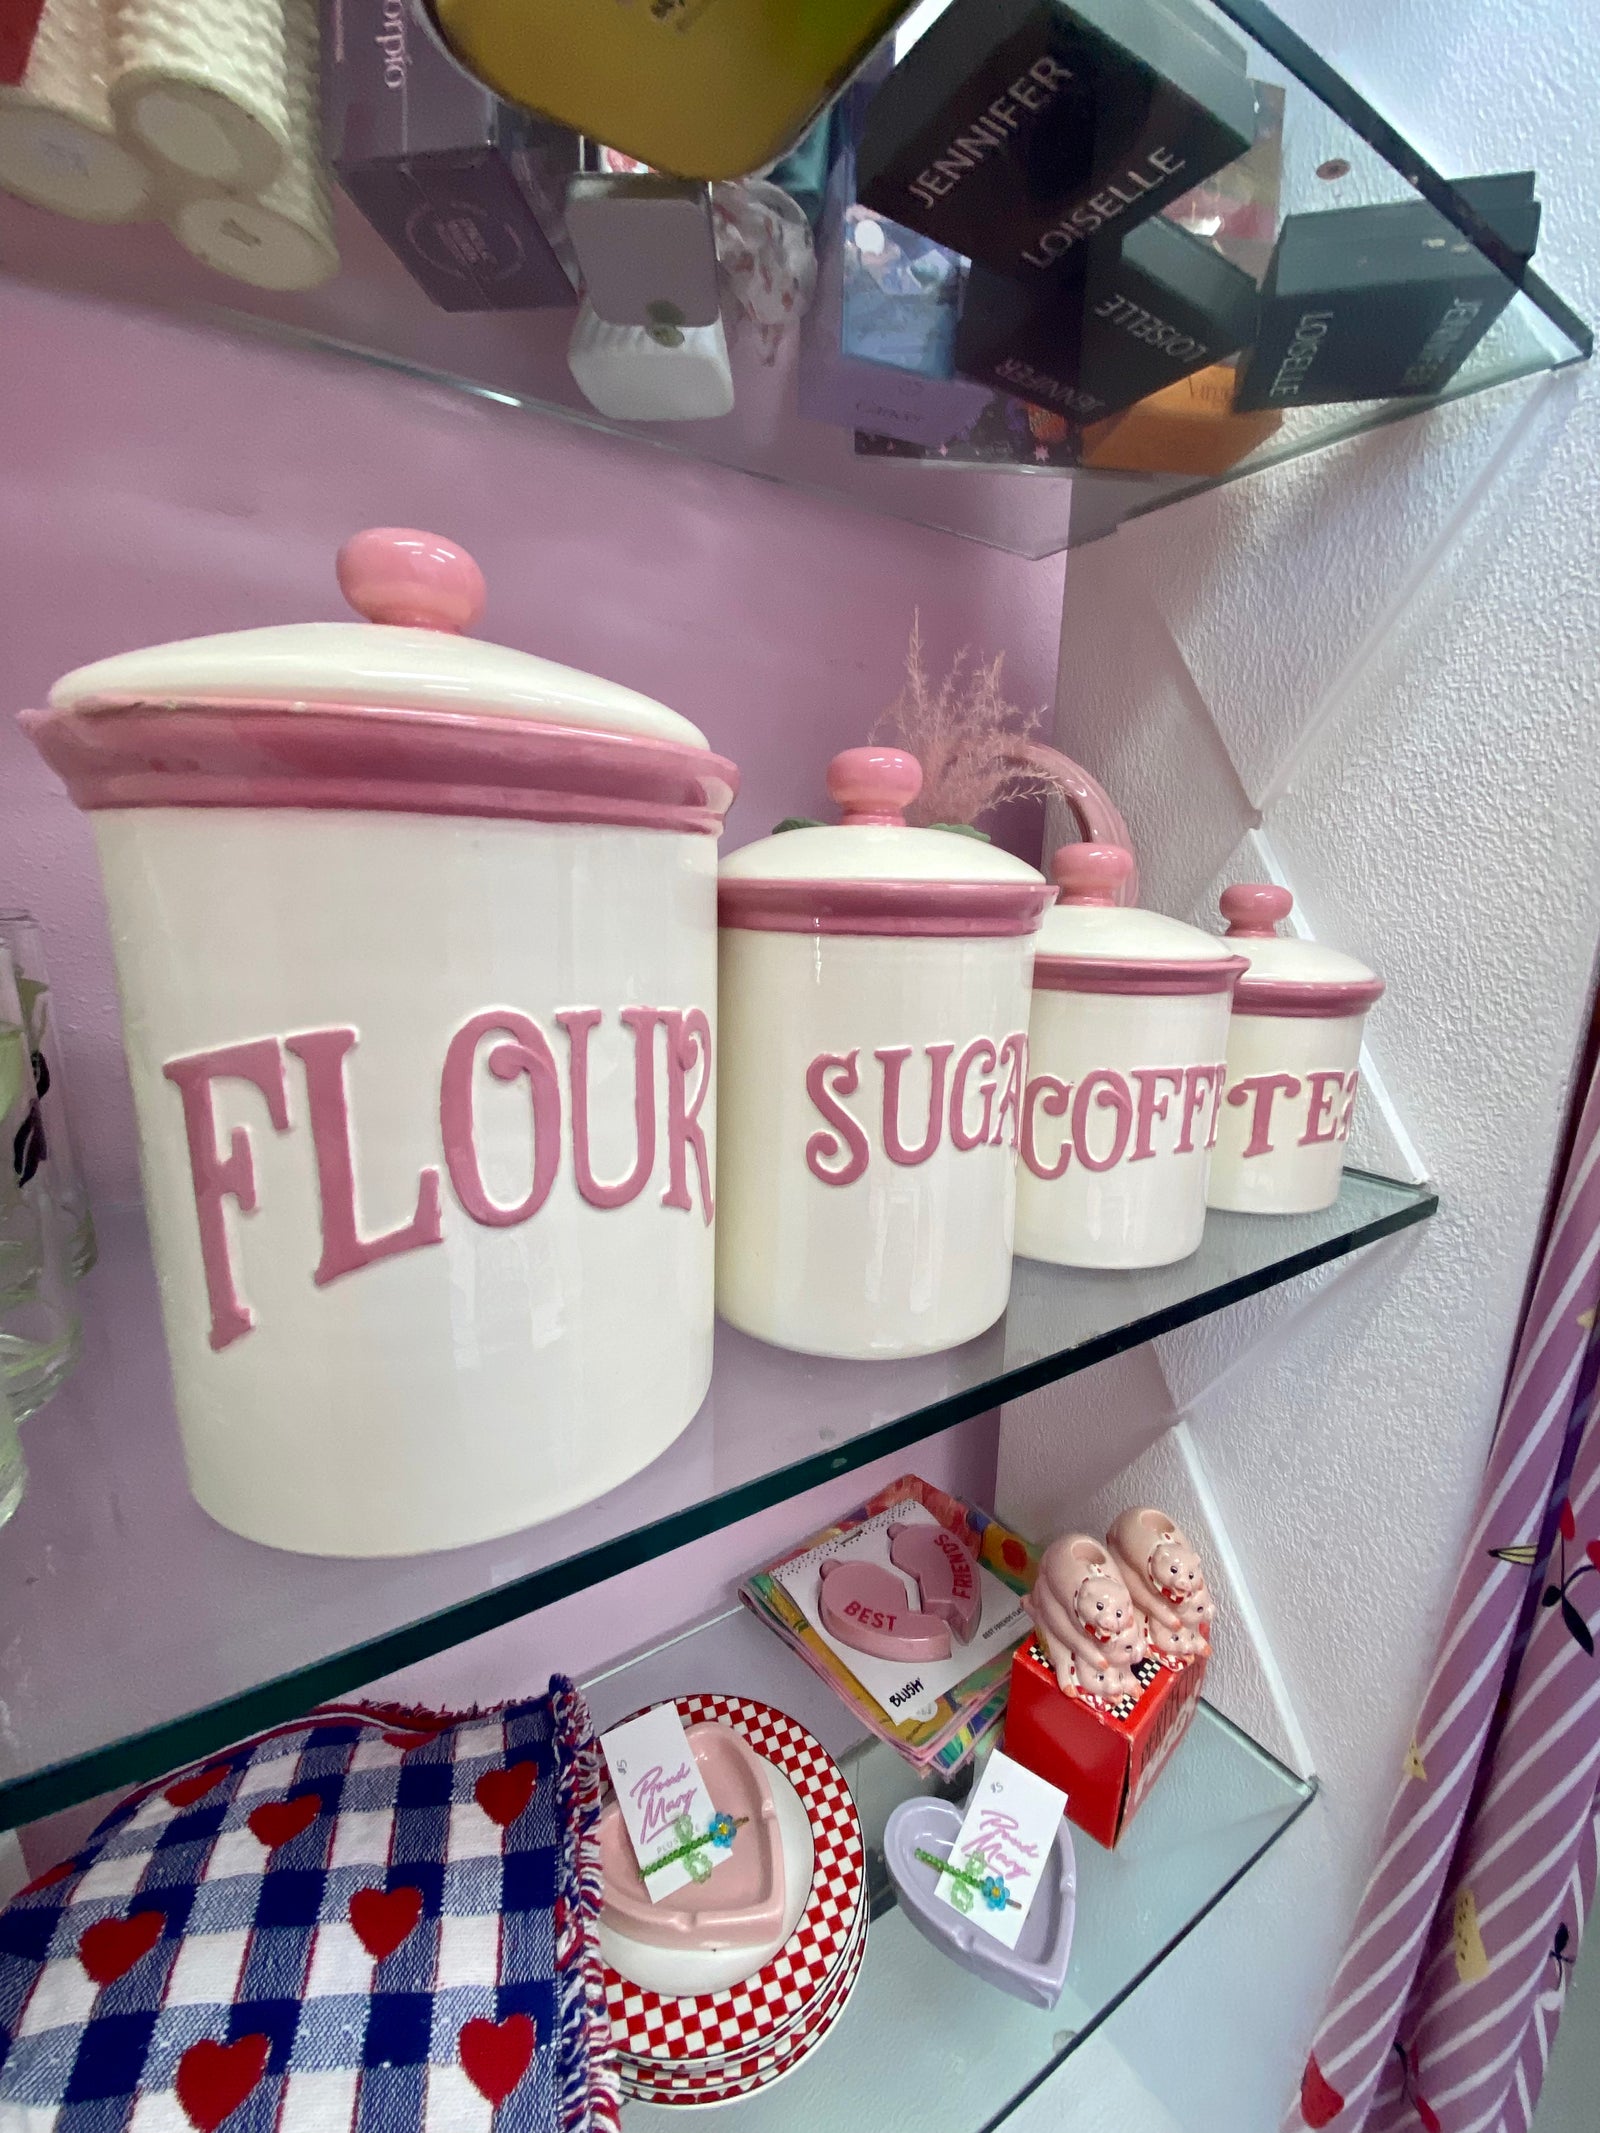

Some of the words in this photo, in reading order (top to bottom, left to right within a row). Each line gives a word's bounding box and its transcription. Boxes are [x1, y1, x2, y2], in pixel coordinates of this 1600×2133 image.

[908, 56, 1074, 209] JENNIFER
[1022, 146, 1186, 269] LOISELLE
[1270, 311, 1333, 397] LOISELLE
[162, 1006, 714, 1352] FLOUR
[934, 1534, 973, 1600] FRIENDS
[843, 1600, 897, 1632] BEST
[889, 1677, 924, 1708] BLUSH
[640, 1787, 698, 1845] Mary
